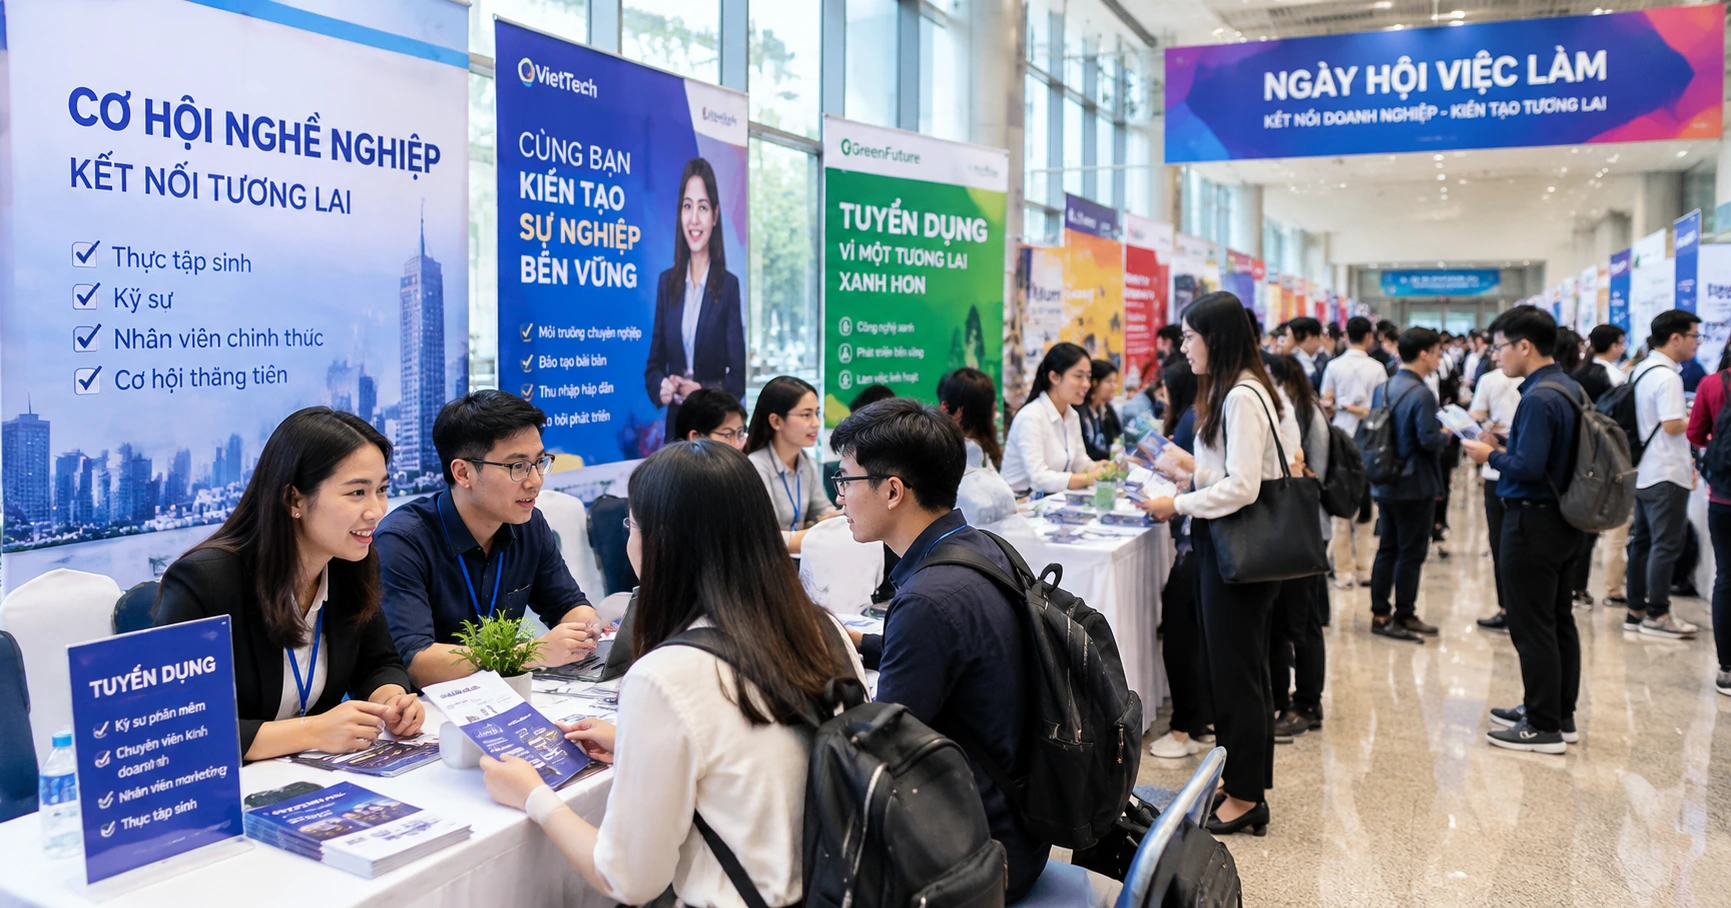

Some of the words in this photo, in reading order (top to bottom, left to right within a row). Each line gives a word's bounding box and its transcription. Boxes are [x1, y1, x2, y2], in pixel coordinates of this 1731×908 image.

[535, 64, 598, 98] VietTech
[1264, 61, 1358, 101] NGÀY
[1366, 56, 1428, 100] HỘI
[1436, 50, 1518, 95] VIỆC
[1527, 45, 1607, 85] LÀM
[1323, 109, 1378, 126] DOANH
[1379, 102, 1438, 124] NGHIỆP
[1488, 100, 1521, 120] TẠO
[1581, 96, 1608, 112] LAI
[68, 87, 132, 131] CƠ
[145, 94, 212, 150] HỘI
[226, 112, 322, 158] NGHỀ
[331, 128, 440, 180] NGHIỆP
[519, 128, 583, 166] CÙNG
[590, 146, 631, 178] BẠN
[852, 142, 921, 164] GreenFuture
[70, 150, 134, 192] KẾT
[145, 160, 198, 200] NỐI
[208, 174, 307, 210] TƯƠNG
[315, 186, 350, 214] LAI
[580, 180, 625, 216] TẠO
[520, 211, 554, 249] SỰ
[560, 217, 641, 256] NGHIỆP
[924, 212, 988, 246] DỤNG
[112, 246, 166, 274] Thực
[172, 250, 206, 275] tập
[212, 252, 252, 272] sinh
[947, 252, 968, 270] LAI
[838, 271, 887, 292] XANH
[148, 292, 174, 313] sự
[114, 328, 172, 350] Nhân
[179, 328, 221, 348] viên
[114, 369, 145, 391] Cơ
[152, 368, 183, 394] hội
[190, 367, 246, 390] thăng
[539, 385, 556, 398] Thu
[162, 656, 216, 684] DỤNG
